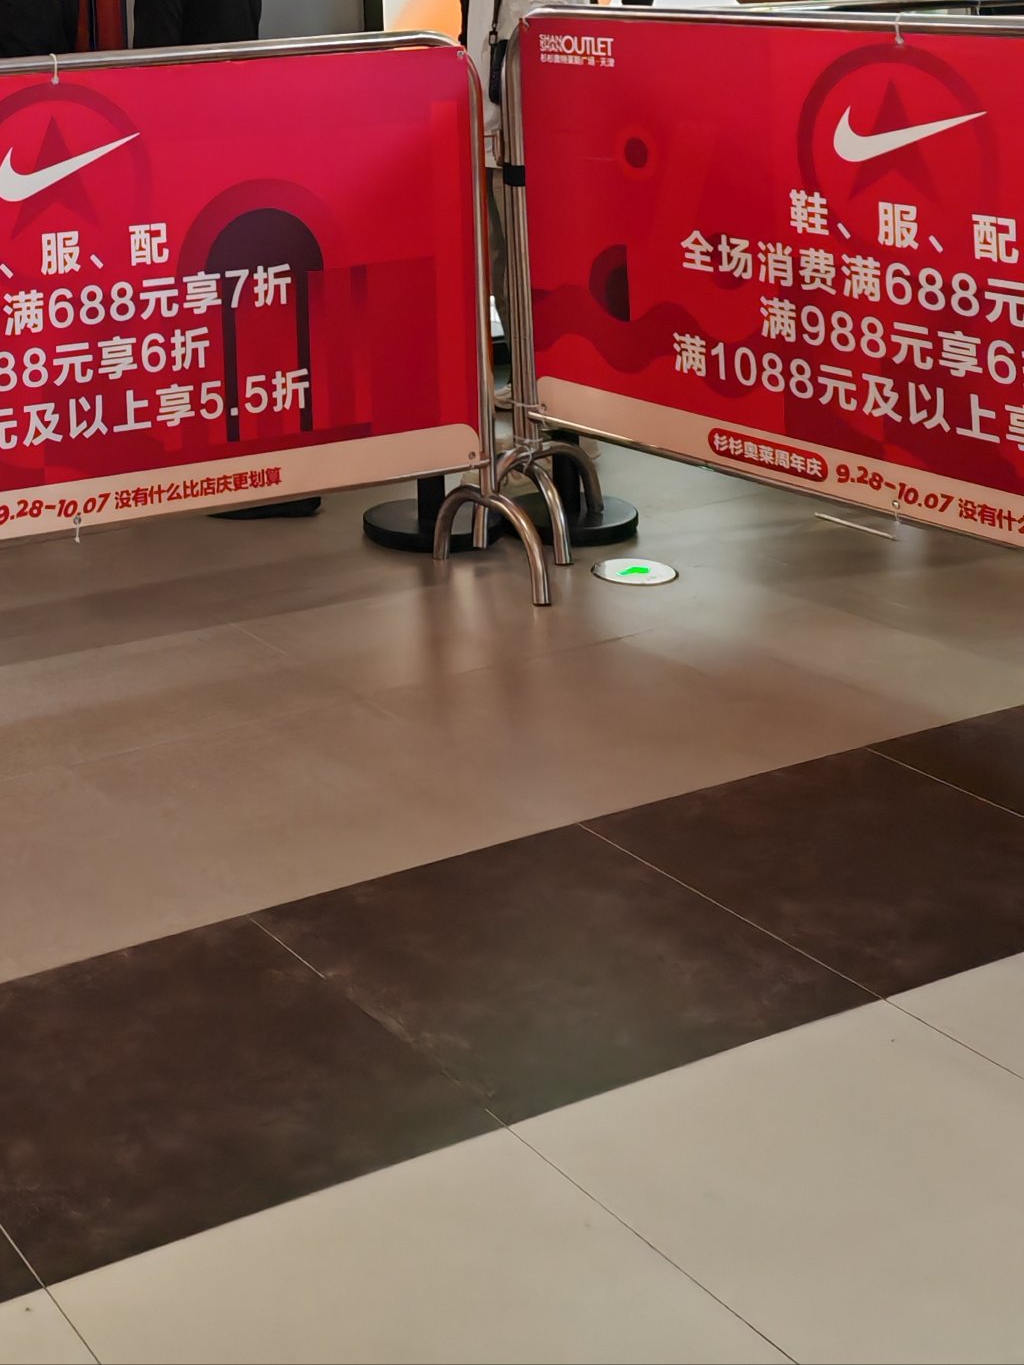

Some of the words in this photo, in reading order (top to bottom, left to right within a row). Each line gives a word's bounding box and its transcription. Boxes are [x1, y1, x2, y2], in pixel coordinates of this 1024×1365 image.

[562, 35, 614, 56] OUTLET
[789, 189, 1019, 264] 鞋、服、配
[760, 295, 1024, 385] 满988元享6
[114, 467, 283, 510] 没有什么比店庆更划算
[713, 433, 823, 478] 杉杉奥莱周年庆
[835, 463, 954, 513] 9.28-10.07
